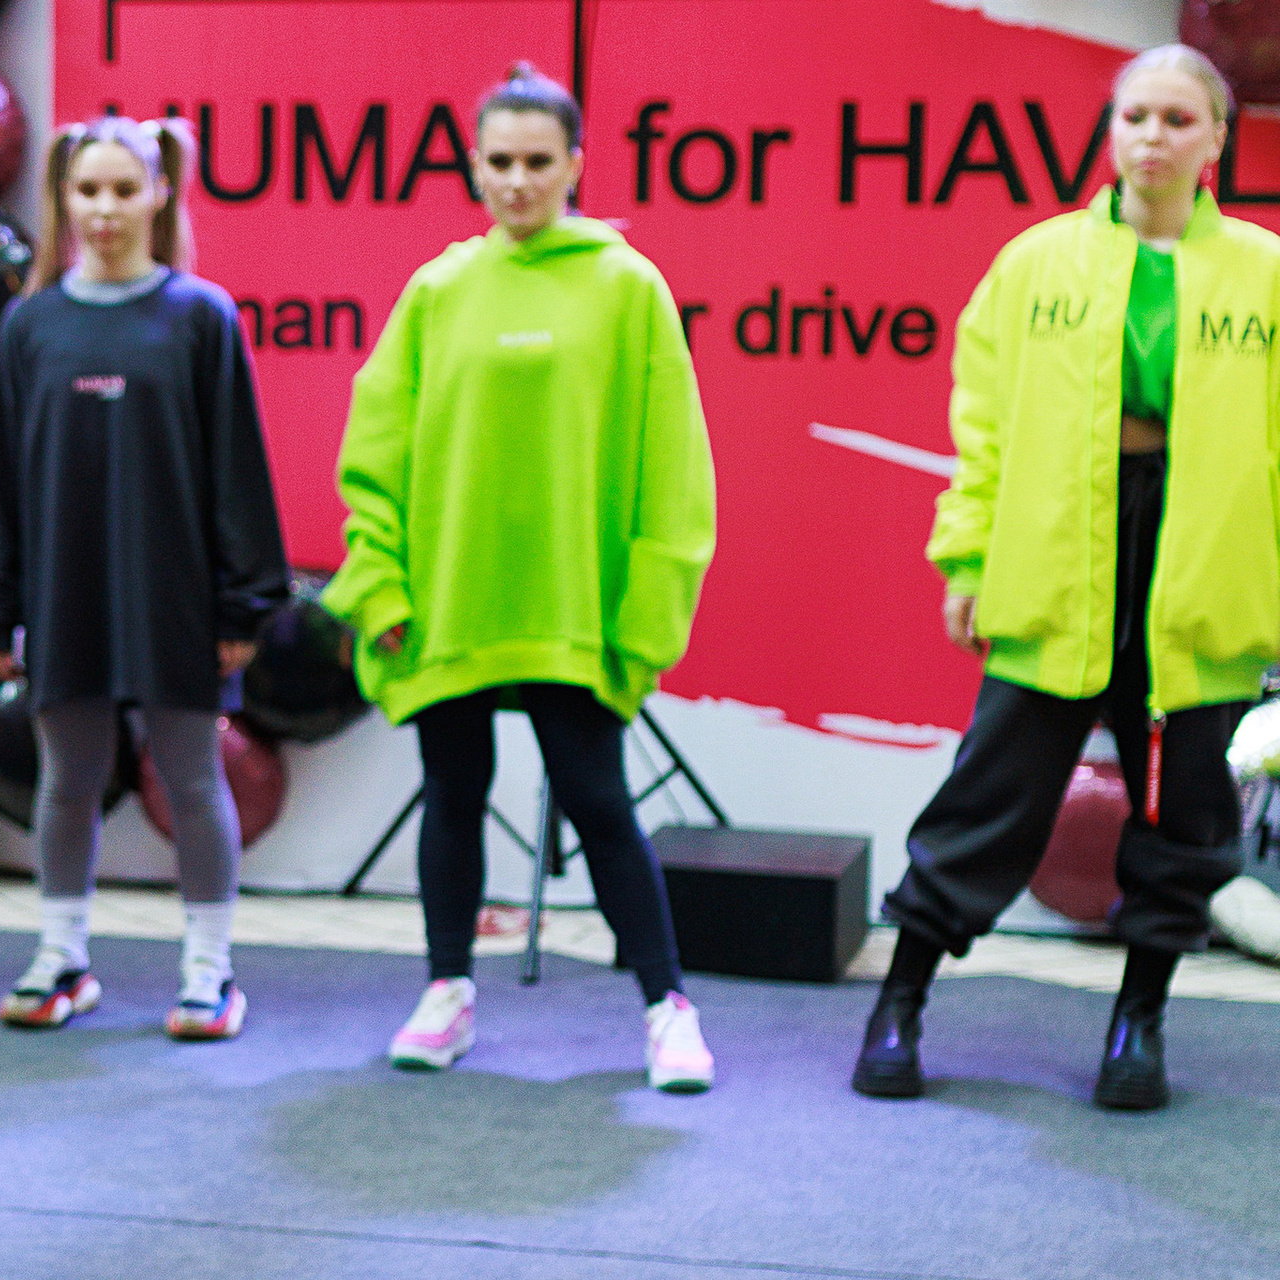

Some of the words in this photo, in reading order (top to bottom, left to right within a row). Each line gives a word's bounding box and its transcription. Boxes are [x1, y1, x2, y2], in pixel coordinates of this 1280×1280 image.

[105, 103, 577, 203] UMA
[629, 102, 791, 203] for
[838, 100, 1280, 205] HAVL
[734, 286, 937, 358] drive
